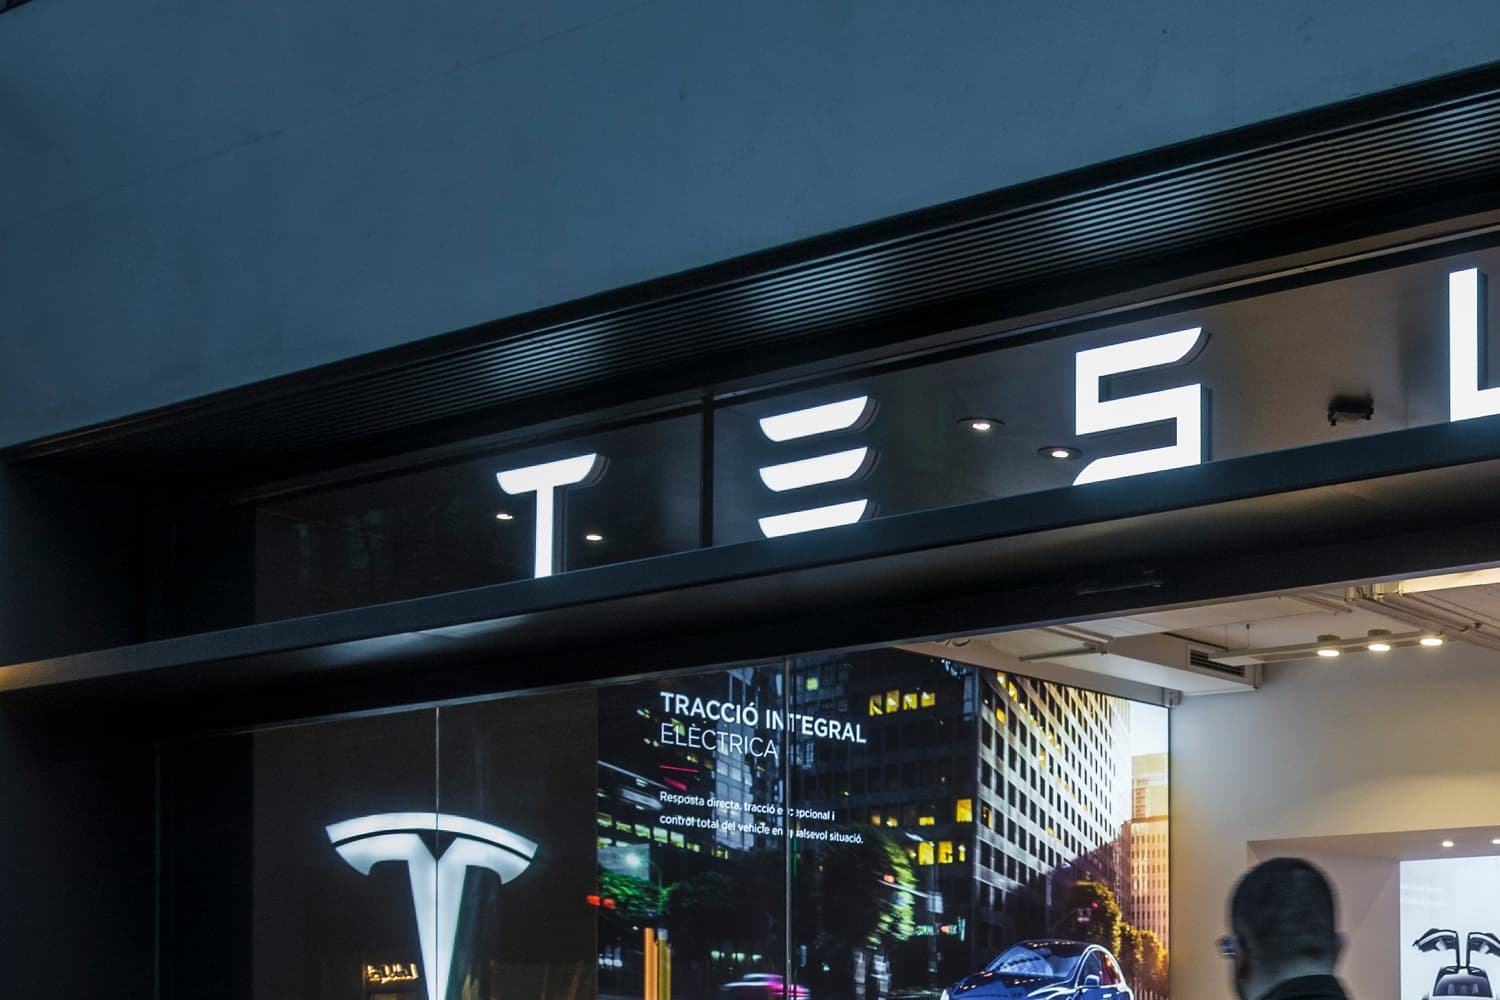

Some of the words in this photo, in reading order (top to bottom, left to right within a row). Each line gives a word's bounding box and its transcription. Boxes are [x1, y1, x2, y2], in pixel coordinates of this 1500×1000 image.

[660, 691, 759, 726] TRACCIÓ
[766, 709, 867, 743] INTEGRAL
[660, 722, 779, 759] ELÈCTRICA
[660, 791, 705, 806] Resposta
[706, 796, 742, 811] directa,
[744, 801, 776, 814] tracció
[777, 807, 830, 820] ecepcional
[660, 814, 695, 825] control
[696, 818, 719, 829] total
[721, 820, 736, 831] del
[738, 823, 770, 835] vehicle
[772, 827, 784, 836] en
[829, 832, 864, 844] situació.
